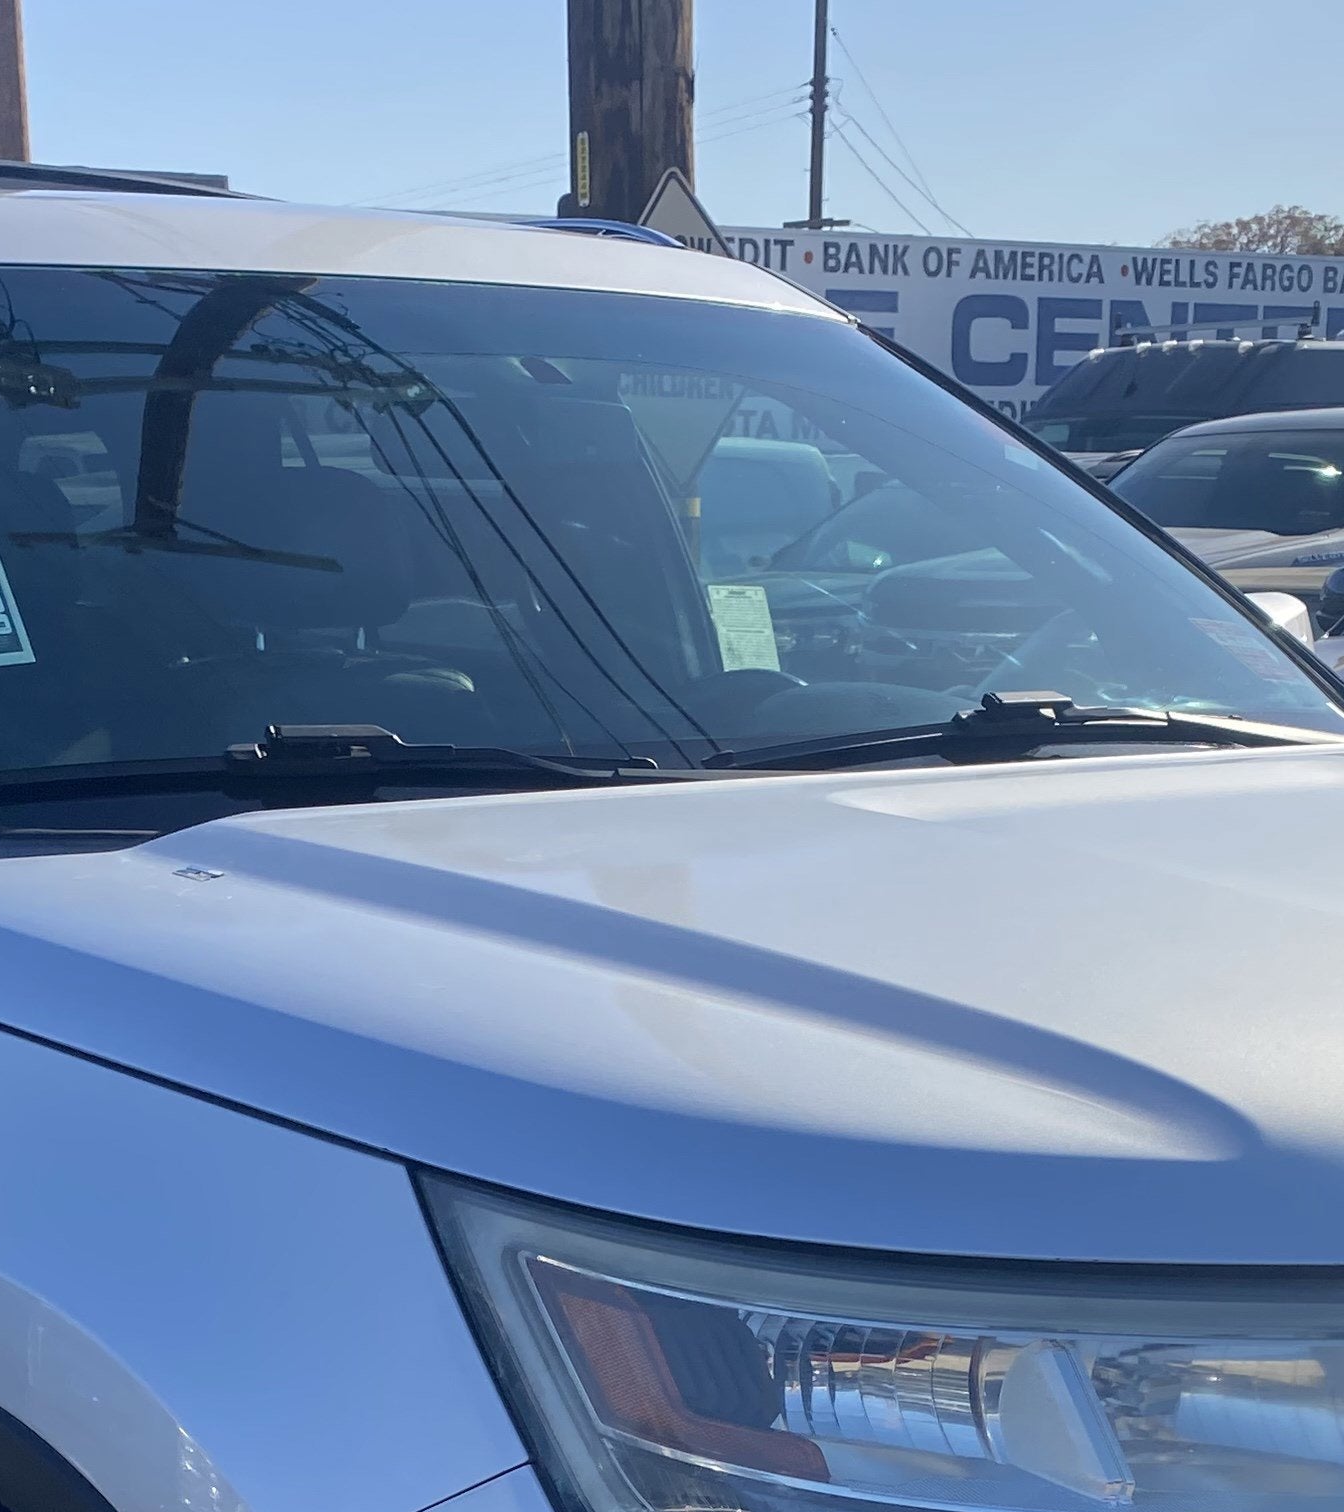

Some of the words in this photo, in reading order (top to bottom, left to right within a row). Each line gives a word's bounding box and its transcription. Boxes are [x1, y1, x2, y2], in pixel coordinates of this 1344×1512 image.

[822, 241, 911, 277] BANK
[922, 246, 962, 278] OF
[969, 248, 1105, 285] AMERICA
[1132, 255, 1219, 289] WELLS
[1228, 261, 1314, 293] FARGO
